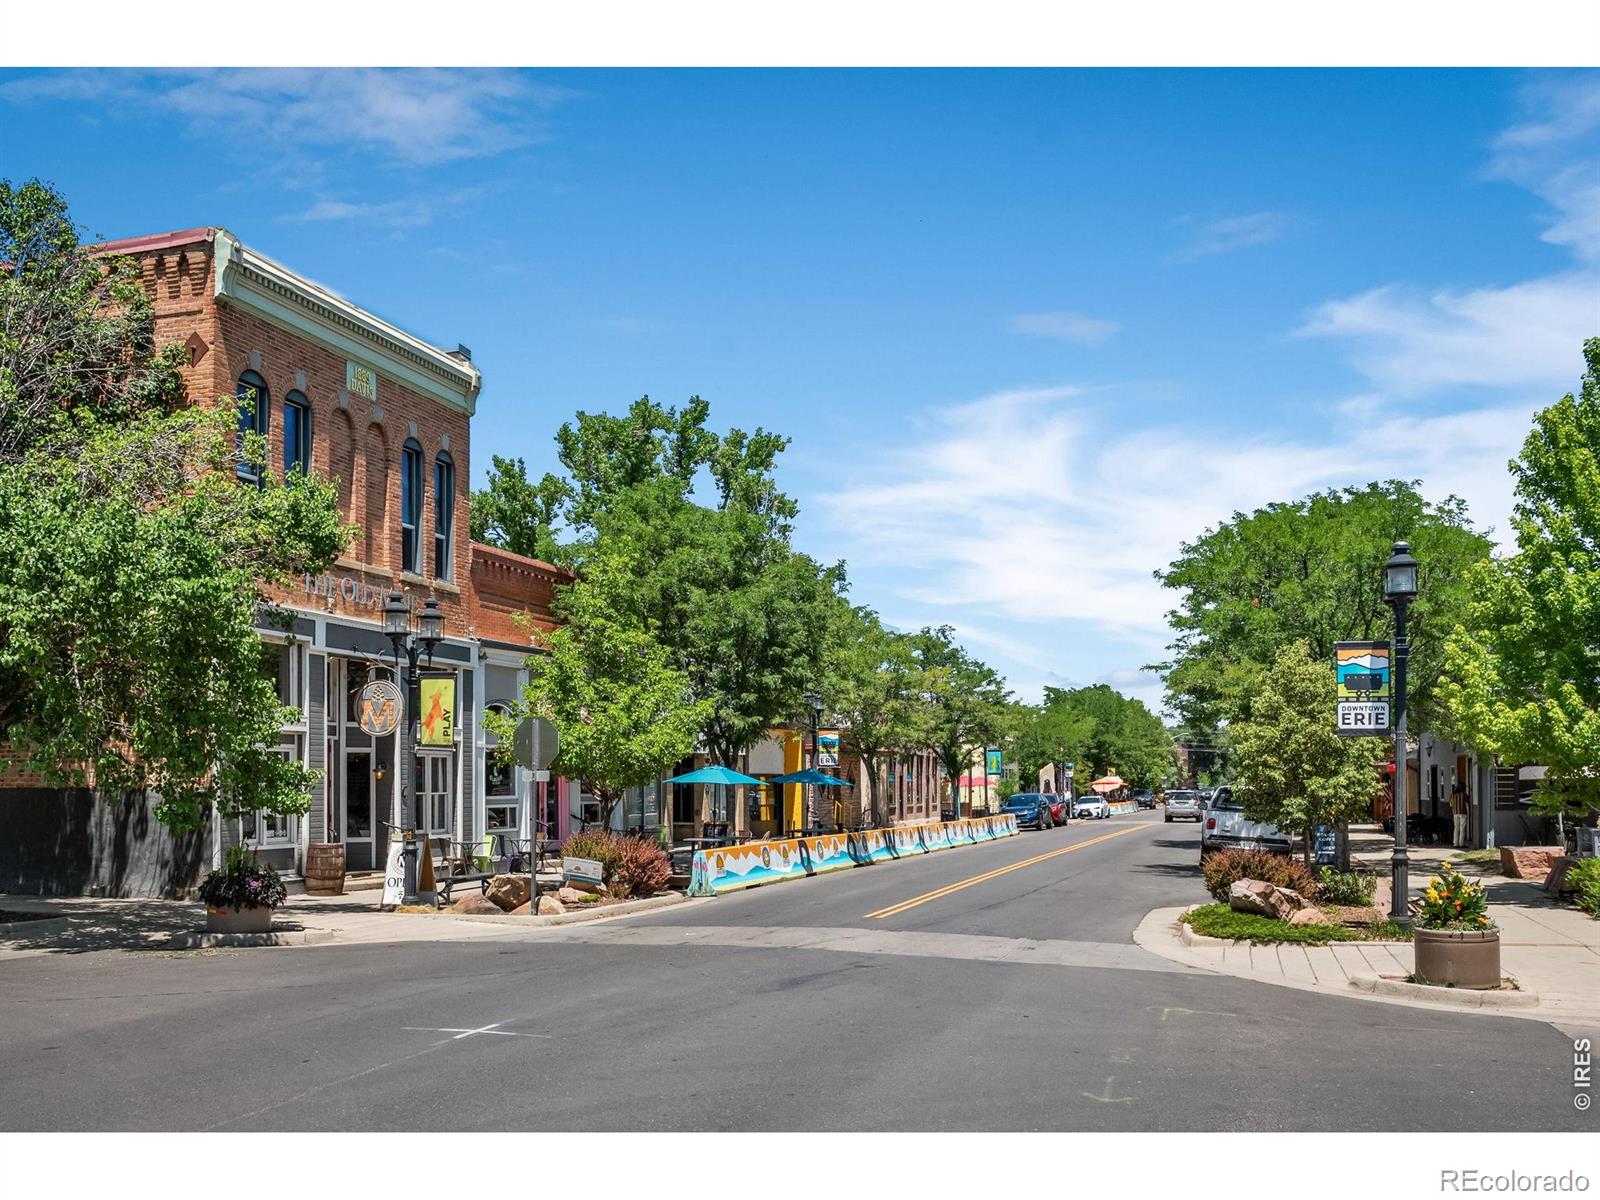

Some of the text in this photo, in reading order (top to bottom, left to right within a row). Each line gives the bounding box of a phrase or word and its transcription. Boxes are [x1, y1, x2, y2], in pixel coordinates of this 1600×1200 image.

[351, 378, 374, 398] DAVIS
[304, 572, 335, 597] THE
[341, 577, 377, 604] OLD
[443, 708, 451, 737] PLAY
[1341, 712, 1386, 725] ERIE
